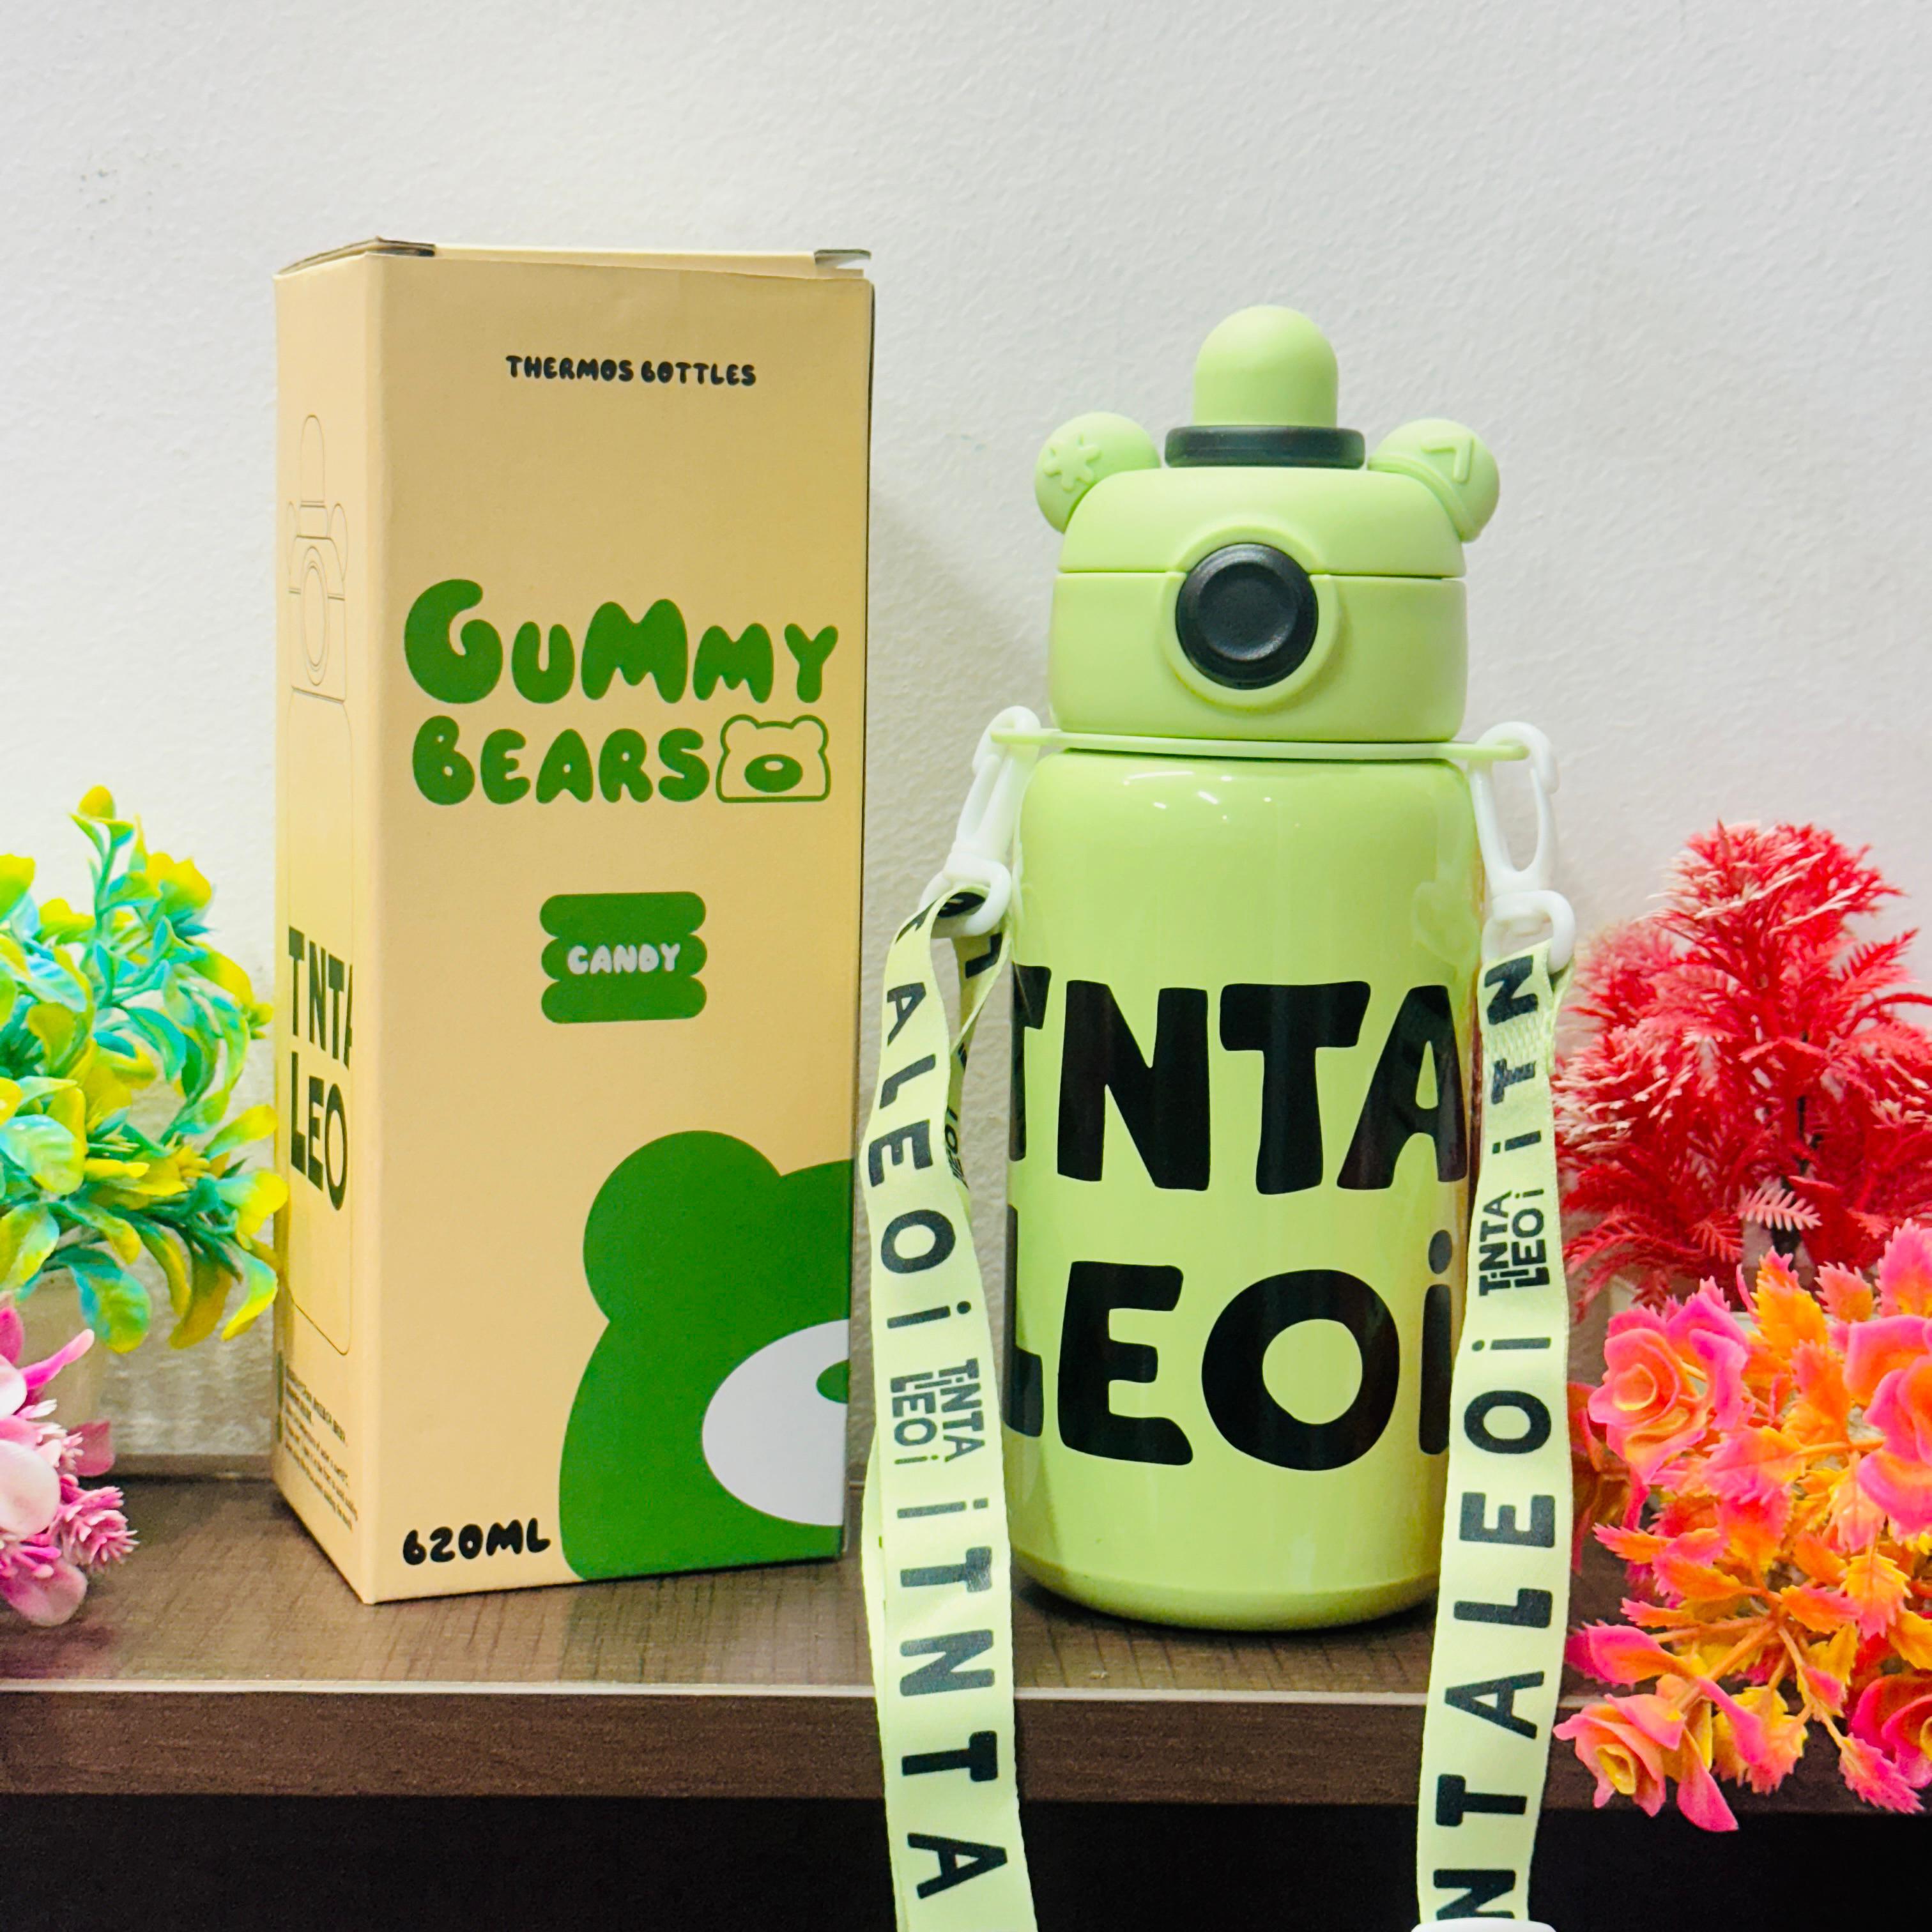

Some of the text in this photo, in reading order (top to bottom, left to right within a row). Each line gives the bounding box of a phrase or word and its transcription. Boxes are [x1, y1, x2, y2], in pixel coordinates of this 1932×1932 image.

[506, 355, 756, 386] THERMOS BOTTLES
[412, 716, 710, 805] BEARS
[567, 943, 680, 974] CANDY
[291, 1051, 348, 1211] LEO
[403, 1517, 551, 1565] 620ML
